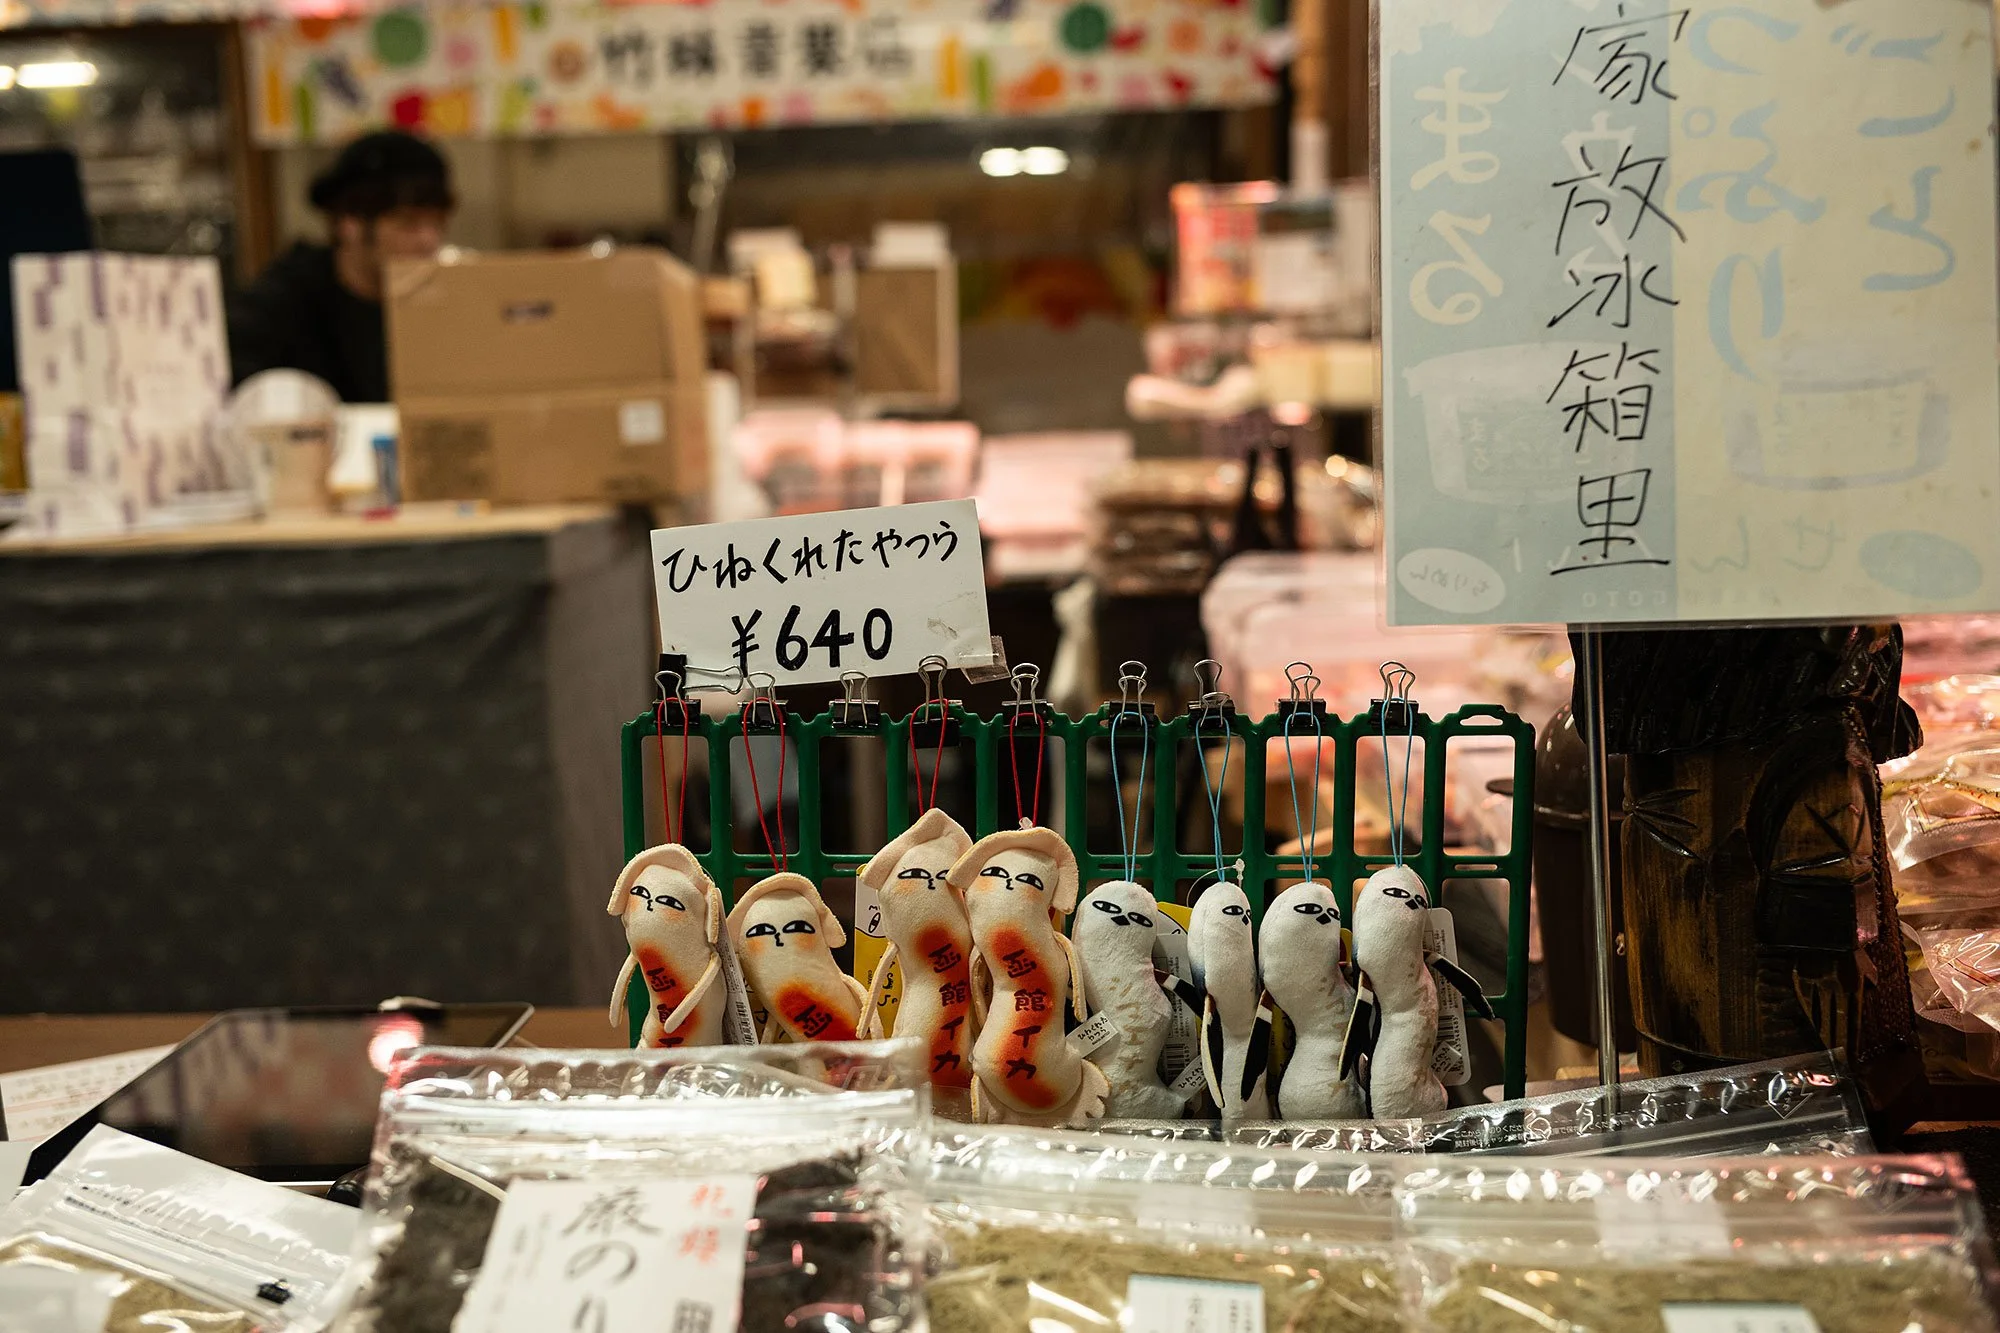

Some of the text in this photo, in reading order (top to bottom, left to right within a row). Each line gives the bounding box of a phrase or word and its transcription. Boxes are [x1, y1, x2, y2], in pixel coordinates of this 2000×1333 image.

[1546, 4, 1690, 576] 家放冰箱里
[731, 605, 893, 678] ¥640
[928, 943, 968, 1073] 函館イカ
[1002, 949, 1048, 1080] 函館イカ
